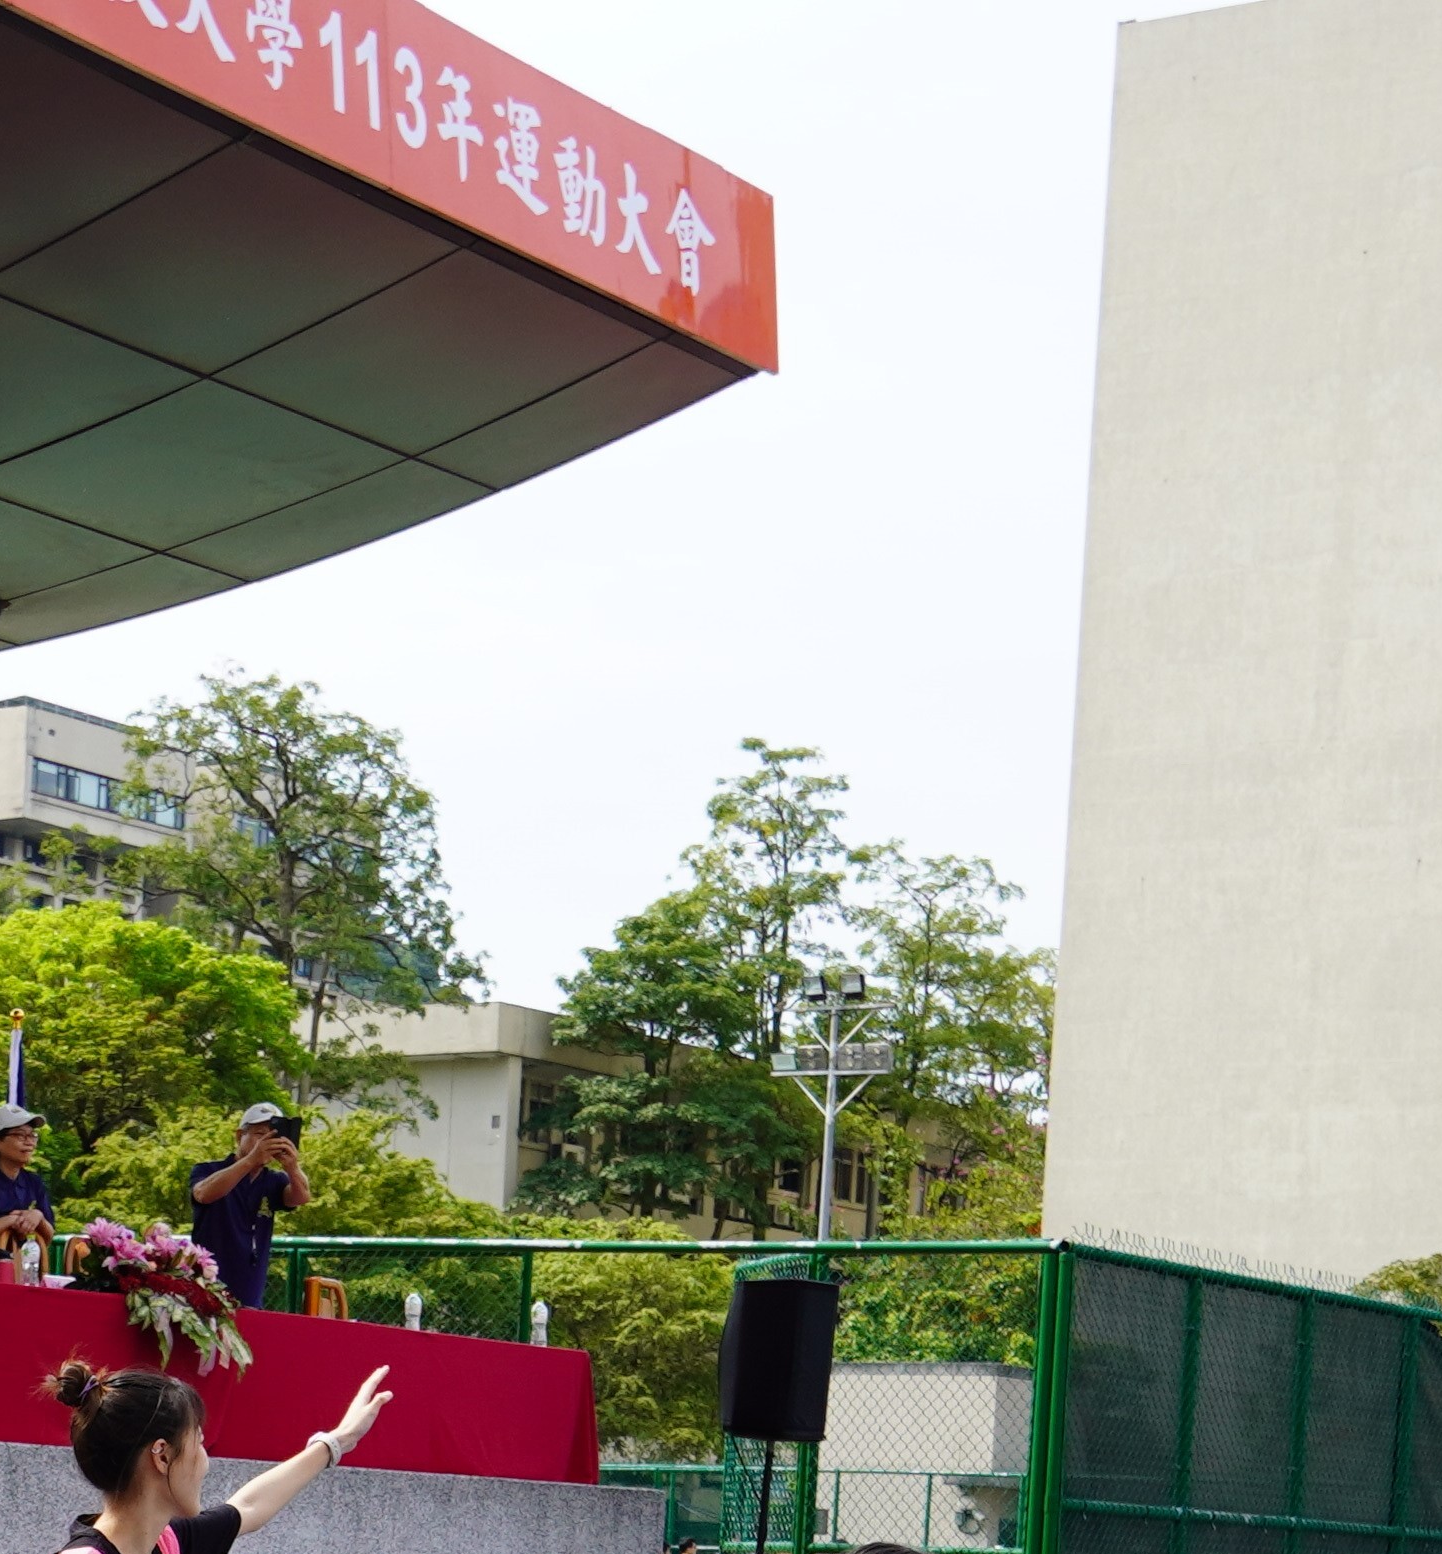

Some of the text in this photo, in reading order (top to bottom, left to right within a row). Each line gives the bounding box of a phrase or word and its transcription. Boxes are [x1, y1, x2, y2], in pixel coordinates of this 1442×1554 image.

[120, 0, 716, 297] 學113年運動大會
